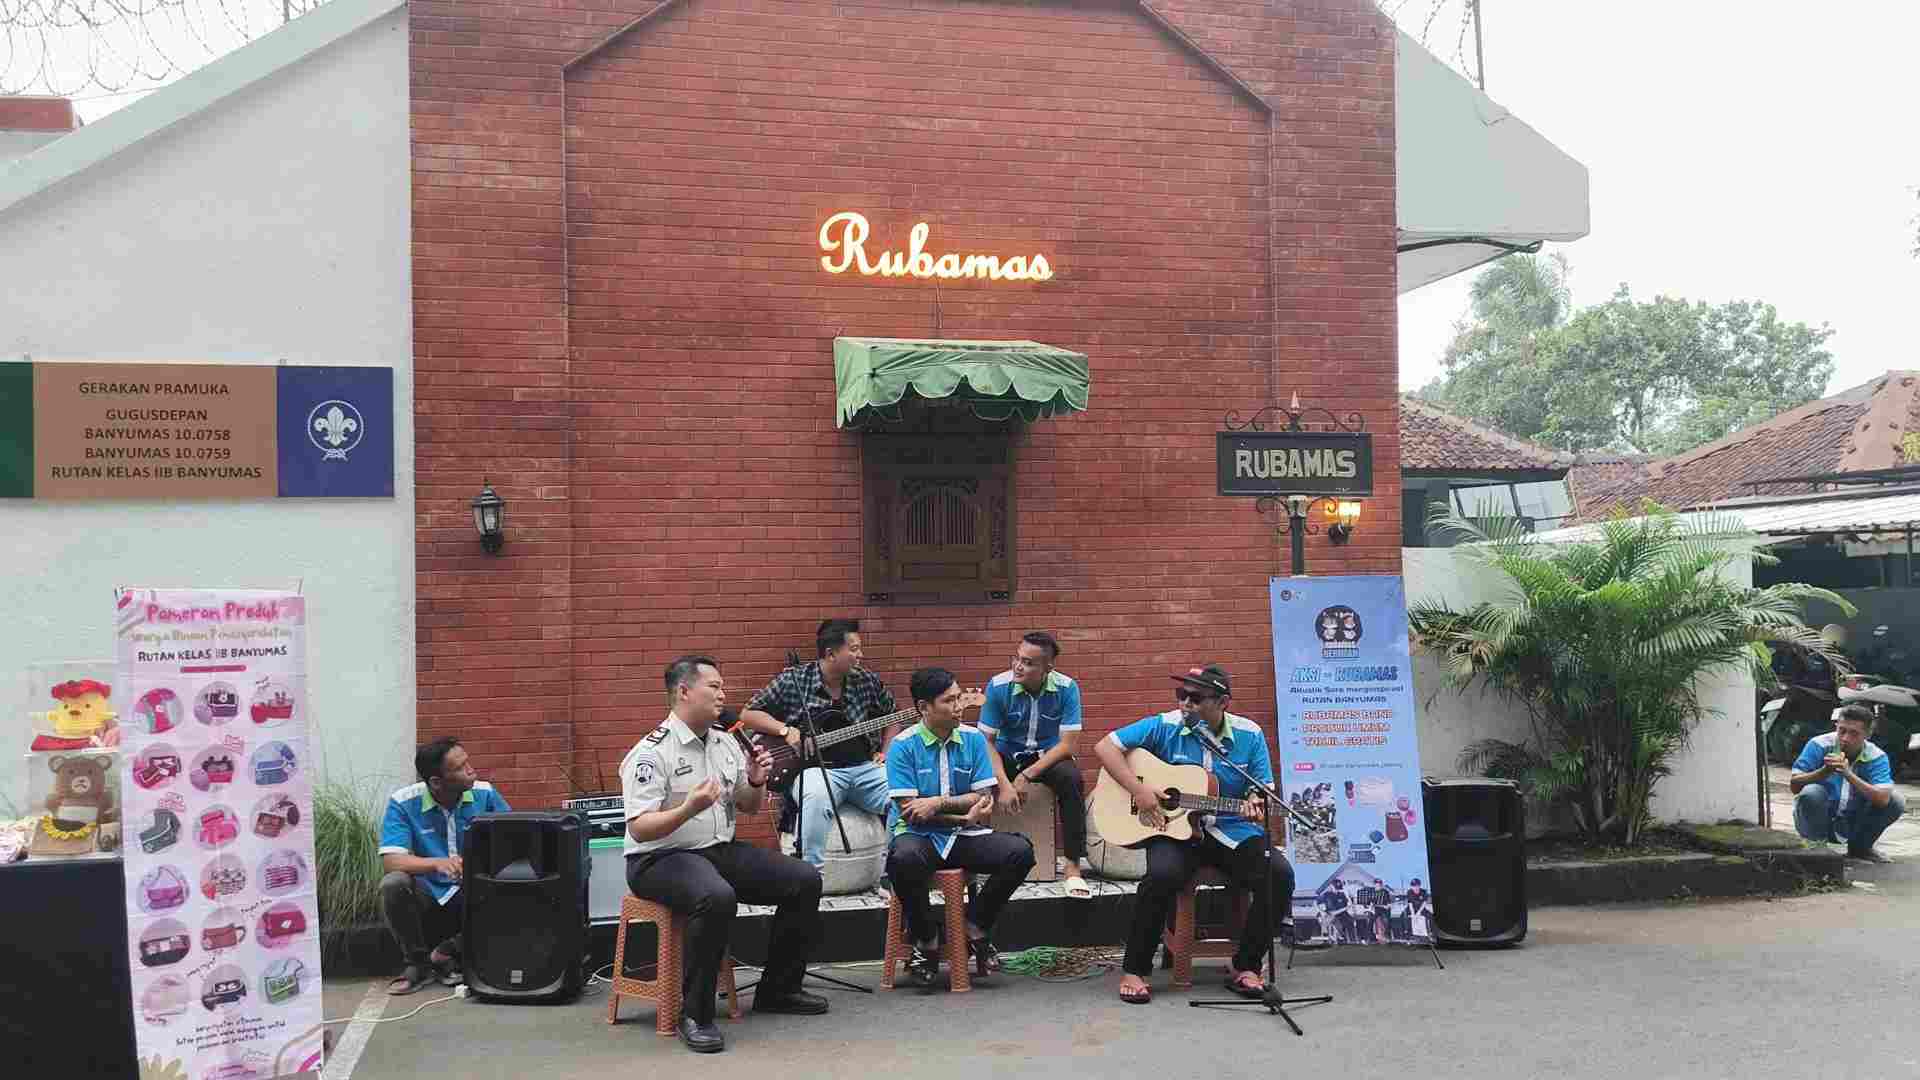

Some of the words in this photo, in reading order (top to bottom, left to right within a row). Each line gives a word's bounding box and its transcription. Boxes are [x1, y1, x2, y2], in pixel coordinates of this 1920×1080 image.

[818, 211, 1053, 281] Rubamas
[79, 382, 150, 395] GERAKAN
[154, 382, 229, 395] PRAMUKA
[105, 409, 208, 422] GUGUSDEPAN
[84, 428, 171, 441] BANYUMAS
[175, 429, 231, 442] 10.0758
[84, 447, 171, 460] BANYUMAS
[175, 448, 231, 460] 10.0759
[1234, 448, 1357, 478] RUBAMAS
[51, 466, 102, 479] RUTAN
[106, 466, 151, 479] KELAS
[154, 466, 173, 479] IIB
[177, 466, 262, 479] BANYUMAS
[146, 603, 221, 623] Pameran
[224, 601, 280, 622] Produk
[138, 650, 175, 662] RUTAN
[177, 648, 211, 661] KELAS
[230, 646, 288, 659] BANYUMAS
